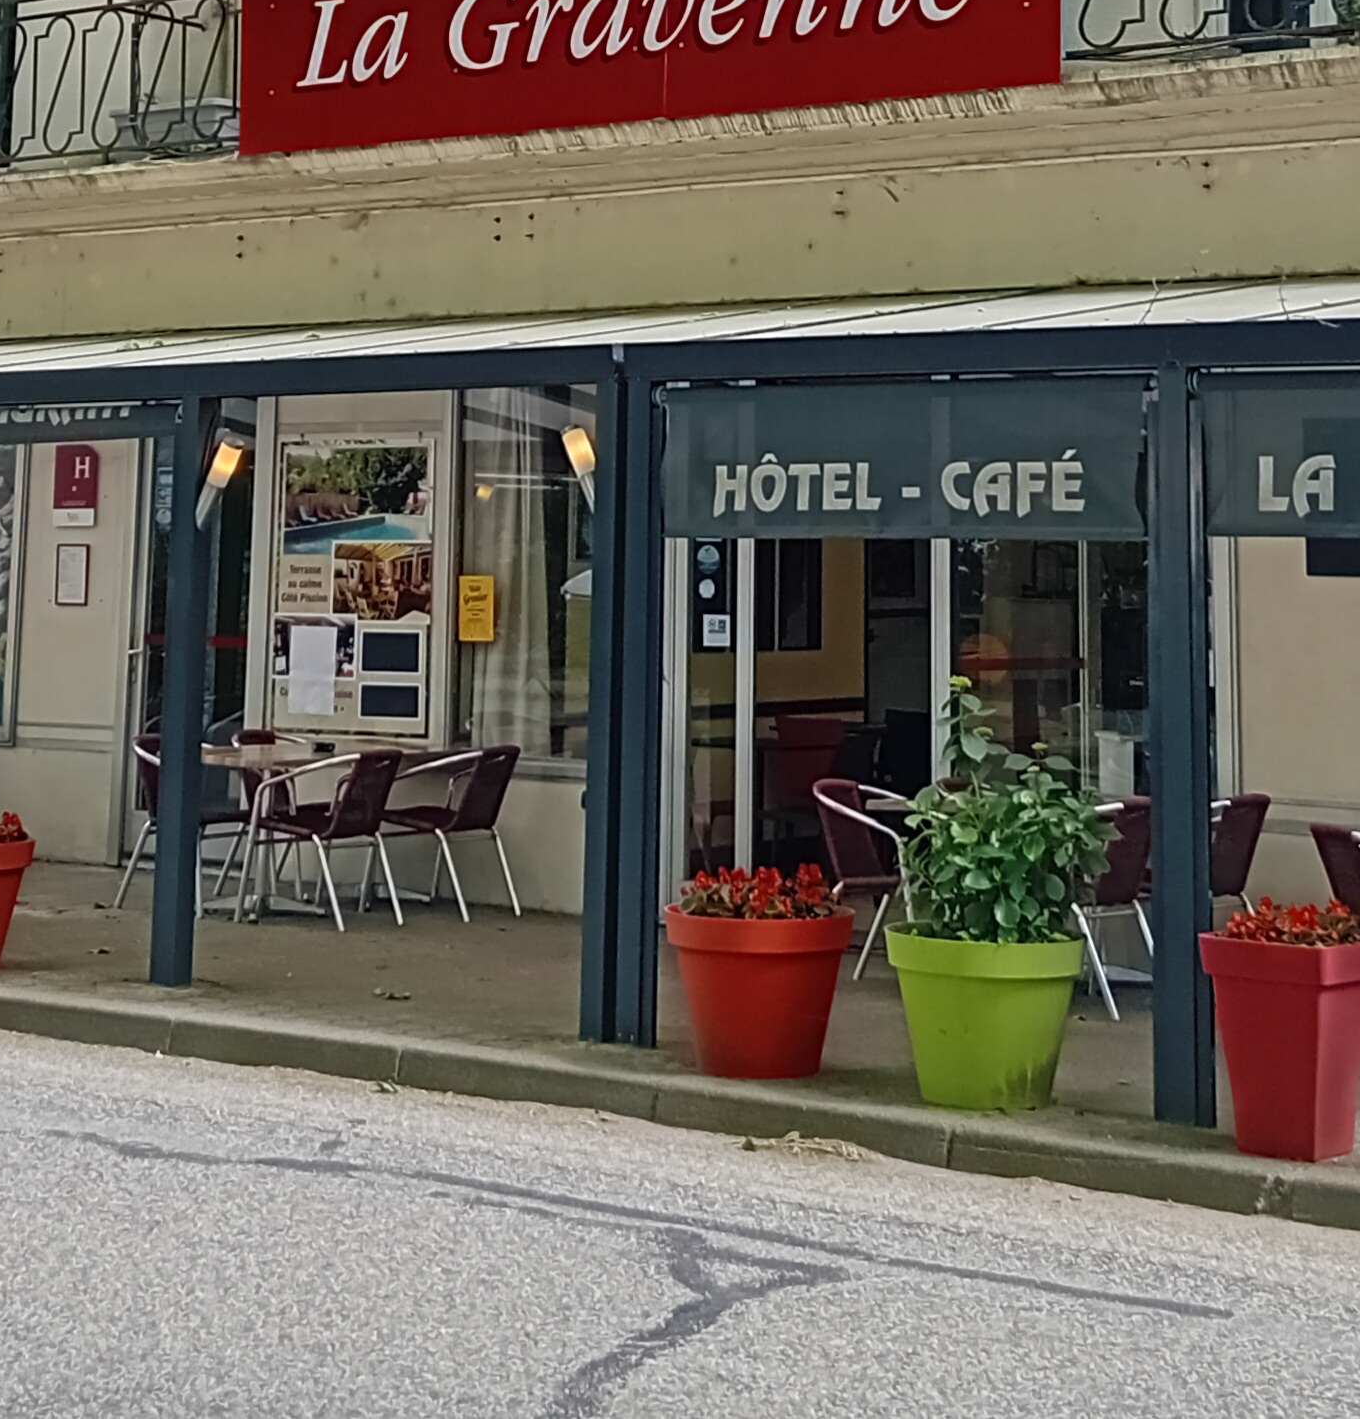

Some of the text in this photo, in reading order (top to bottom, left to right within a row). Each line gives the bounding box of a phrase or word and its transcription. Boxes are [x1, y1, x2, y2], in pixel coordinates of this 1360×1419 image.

[73, 455, 91, 479] H
[713, 452, 882, 518] HÔTEL
[941, 448, 1085, 519] CAFÉ
[1257, 453, 1337, 518] LA
[288, 563, 322, 575] Terrasse
